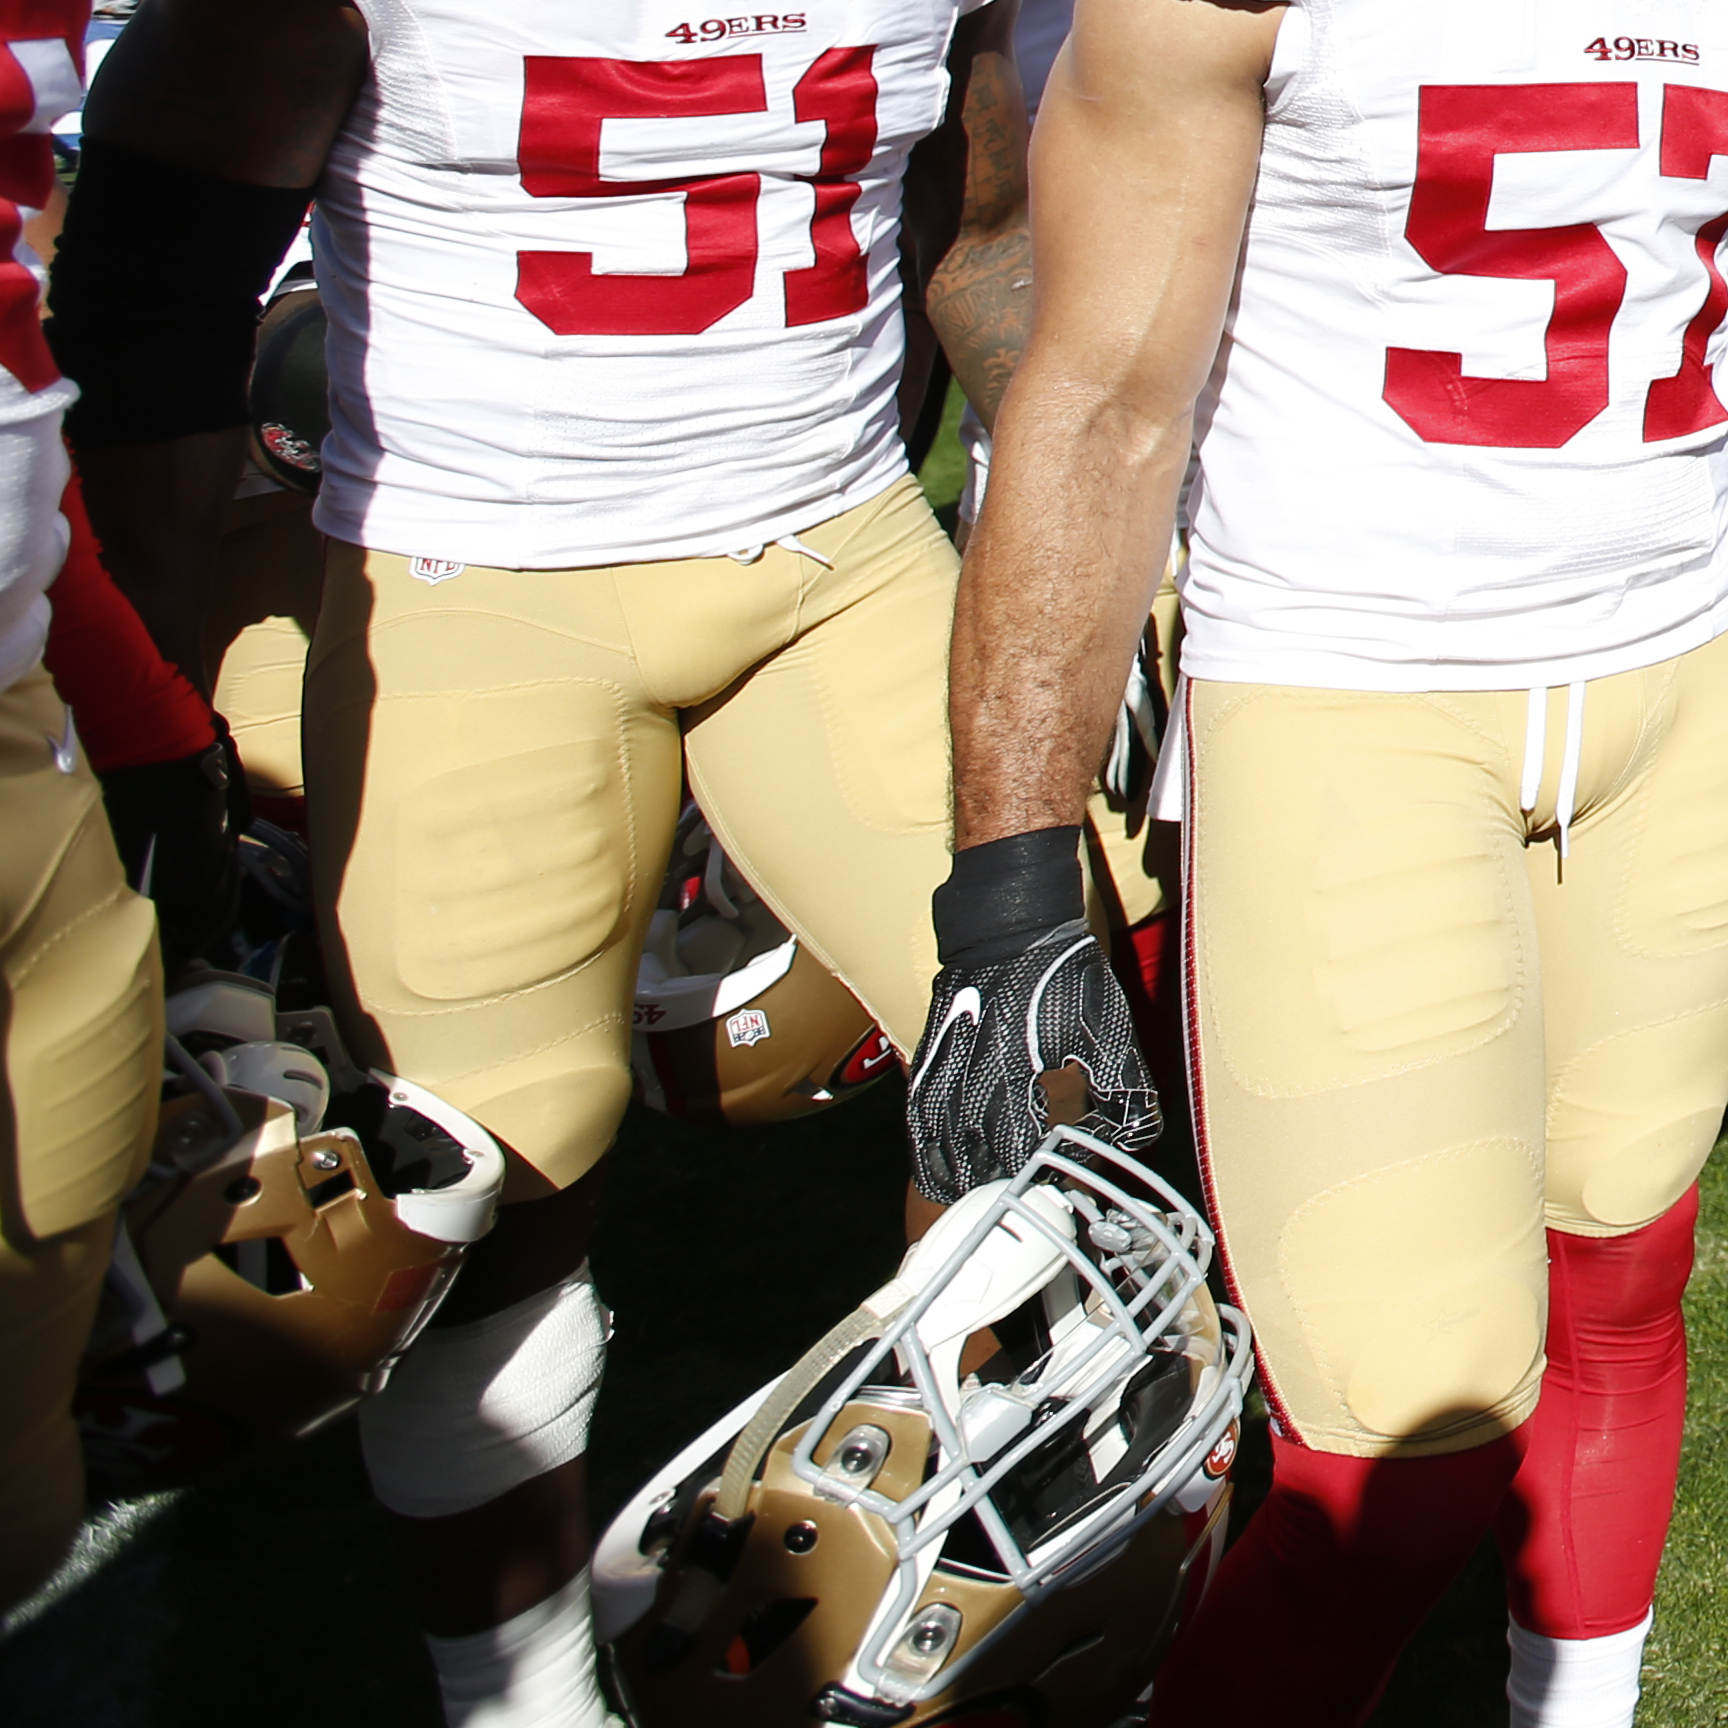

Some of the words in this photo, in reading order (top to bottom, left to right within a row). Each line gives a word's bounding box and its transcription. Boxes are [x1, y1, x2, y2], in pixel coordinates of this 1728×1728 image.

[664, 12, 807, 44] 49ERS
[1584, 36, 1700, 66] 49ERS
[515, 44, 878, 335] 51
[732, 1015, 761, 1033] NFL
